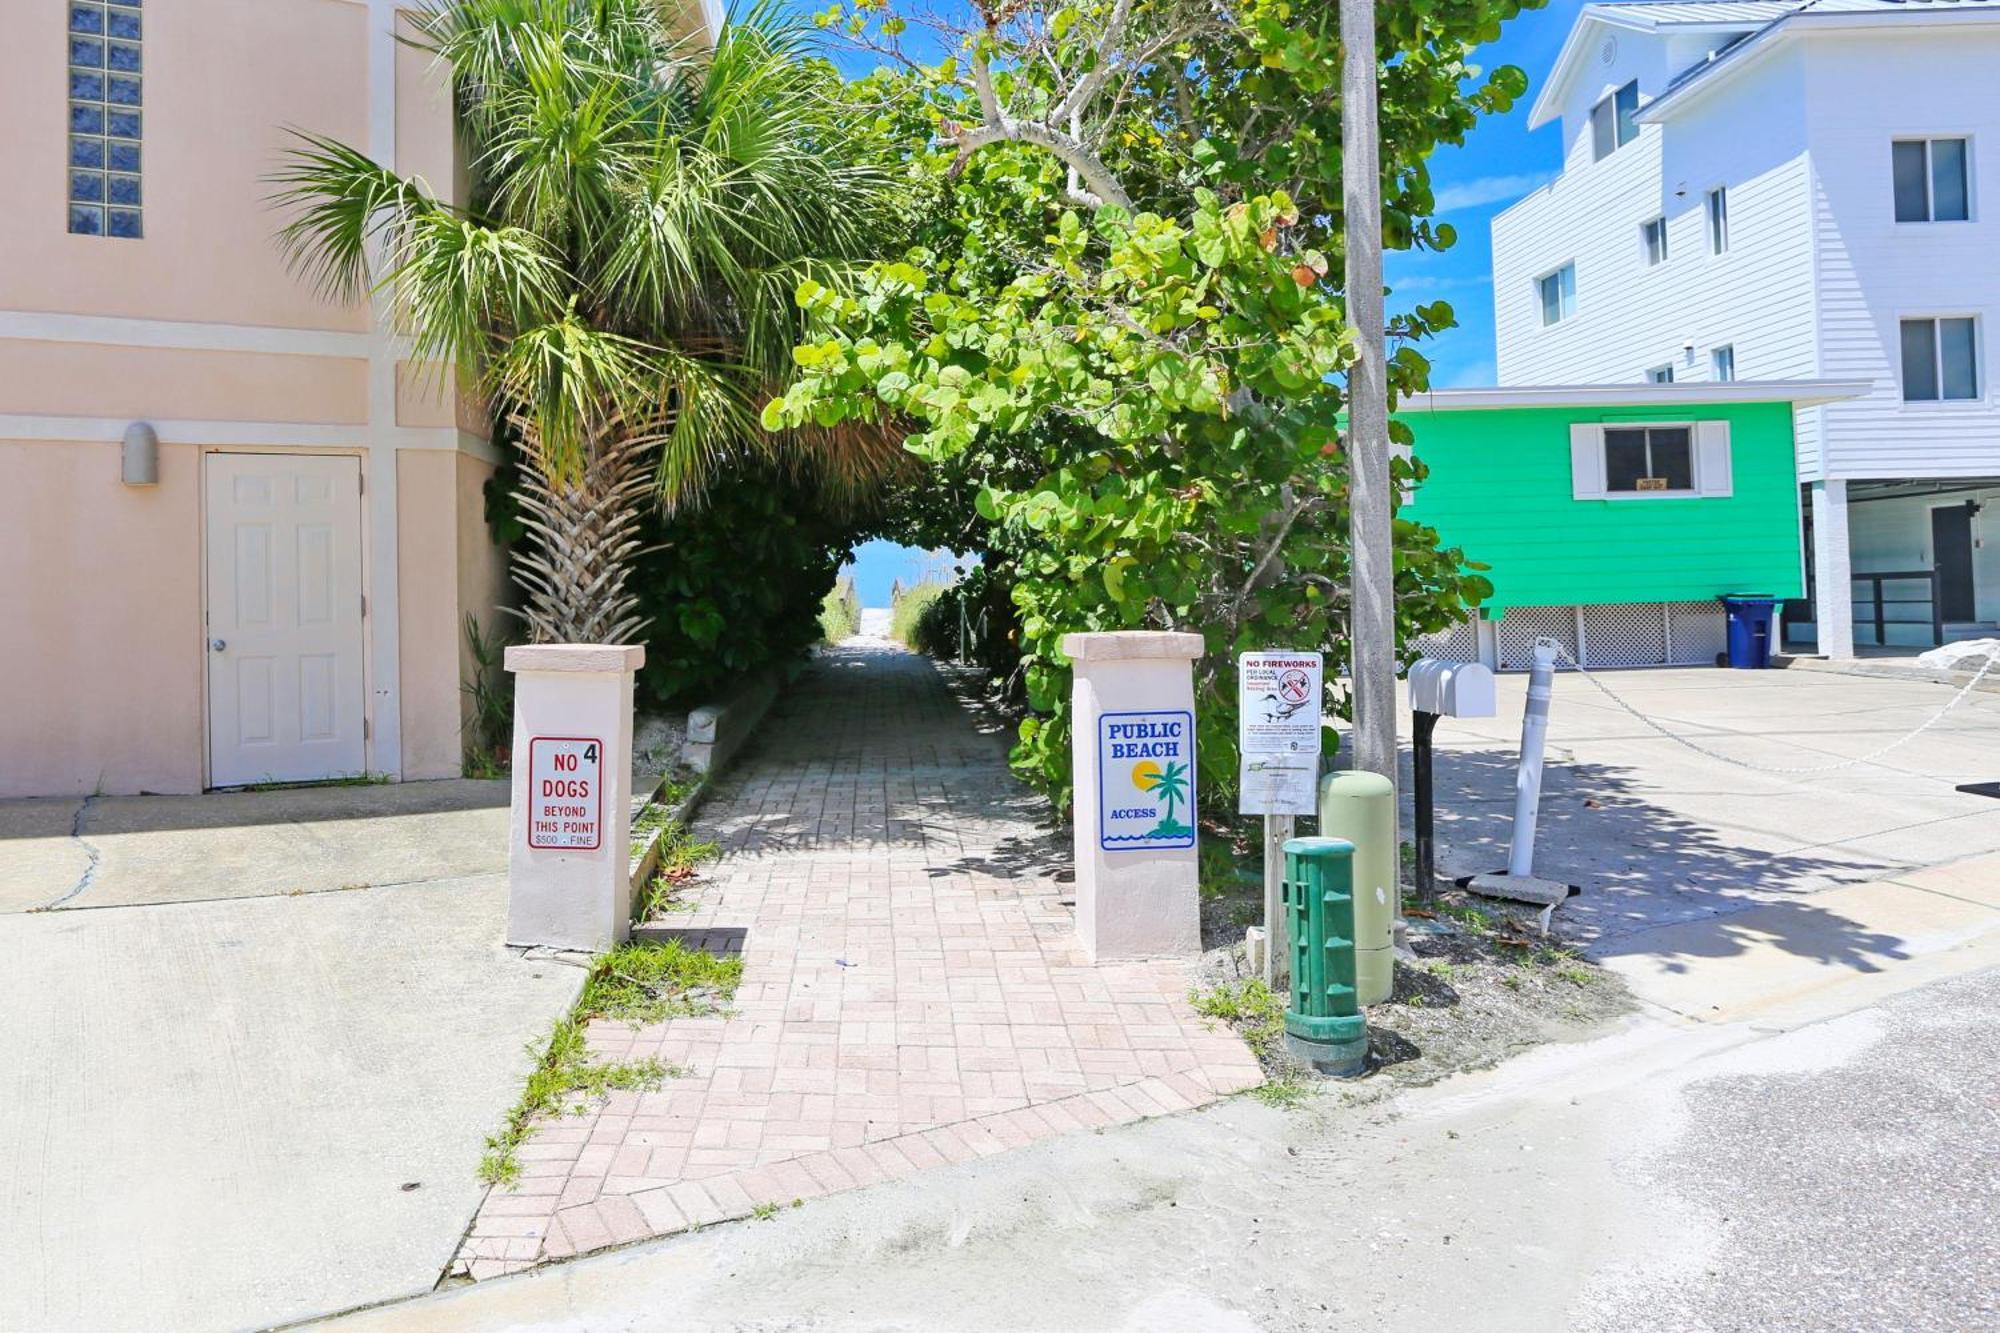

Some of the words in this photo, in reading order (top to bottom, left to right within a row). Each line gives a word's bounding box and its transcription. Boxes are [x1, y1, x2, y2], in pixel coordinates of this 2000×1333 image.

[1246, 660, 1260, 668] NO
[1262, 660, 1317, 668] FIREWORKS
[1108, 722, 1182, 740] PUBLIC
[583, 743, 598, 764] 4
[1111, 741, 1180, 759] BEACH
[554, 753, 578, 772] NO
[542, 779, 589, 798] DOGS
[543, 805, 587, 818] BEYOND
[1110, 808, 1157, 820] ACCESS
[535, 821, 559, 833] THIS
[563, 822, 595, 834] POINT
[535, 834, 558, 845] $500
[570, 835, 594, 846] FINE
